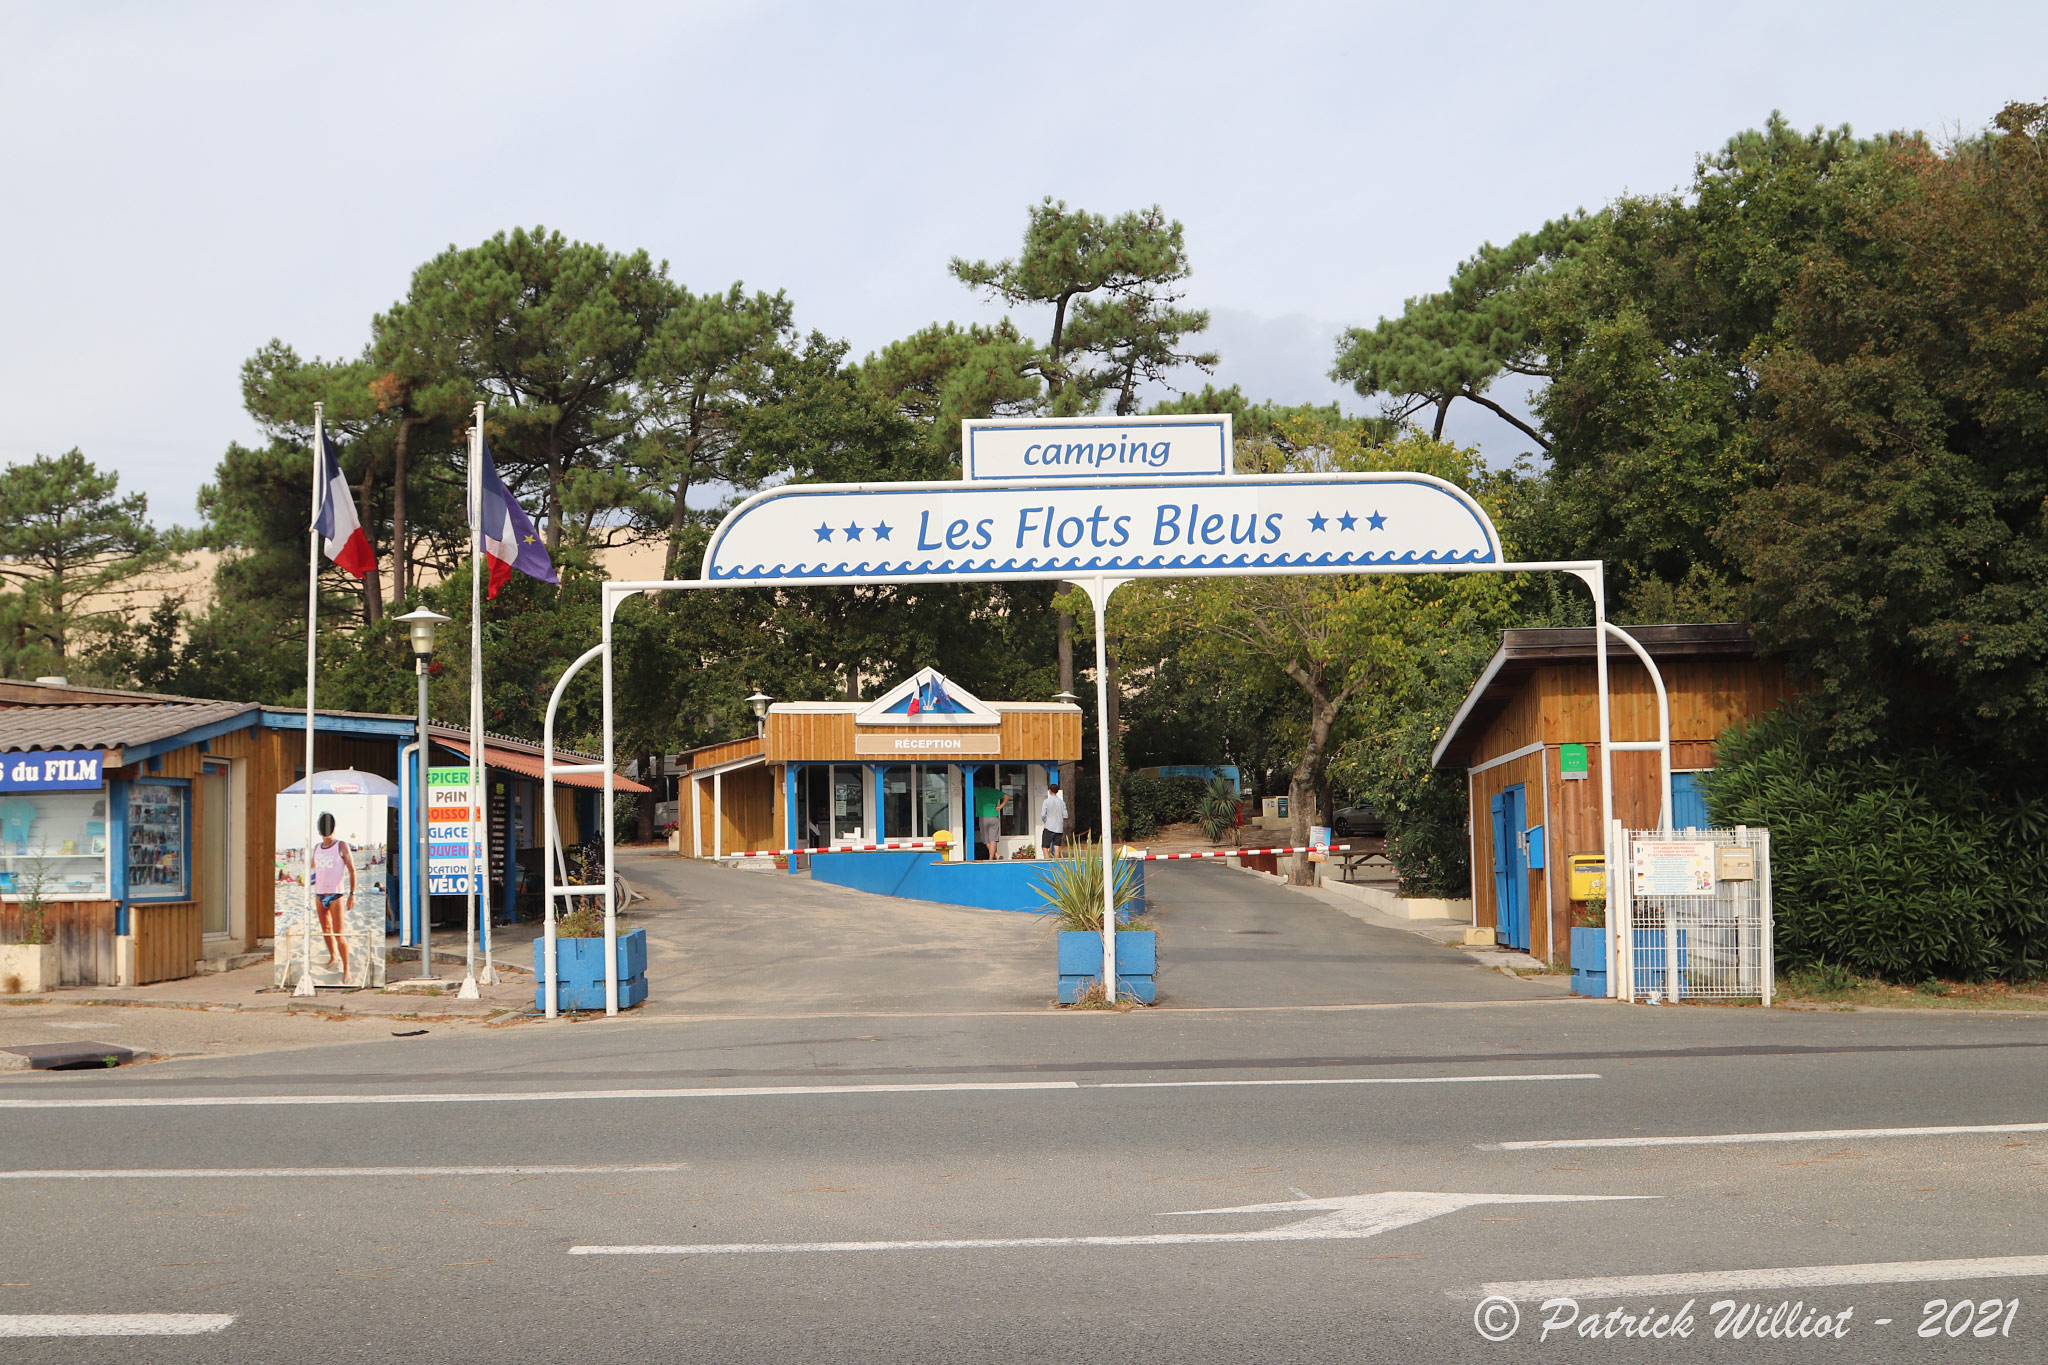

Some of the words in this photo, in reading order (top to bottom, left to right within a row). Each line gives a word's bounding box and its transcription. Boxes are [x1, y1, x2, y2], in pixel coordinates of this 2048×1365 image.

[1024, 434, 1171, 468] camping
[917, 510, 994, 551] Les
[1016, 505, 1132, 549] Flots
[1153, 504, 1283, 545] Bleus
[894, 738, 961, 749] RÉCEPTION
[12, 761, 39, 782] du
[44, 759, 98, 781] FILM
[436, 791, 467, 803] PAIN
[428, 865, 467, 874] OCATION
